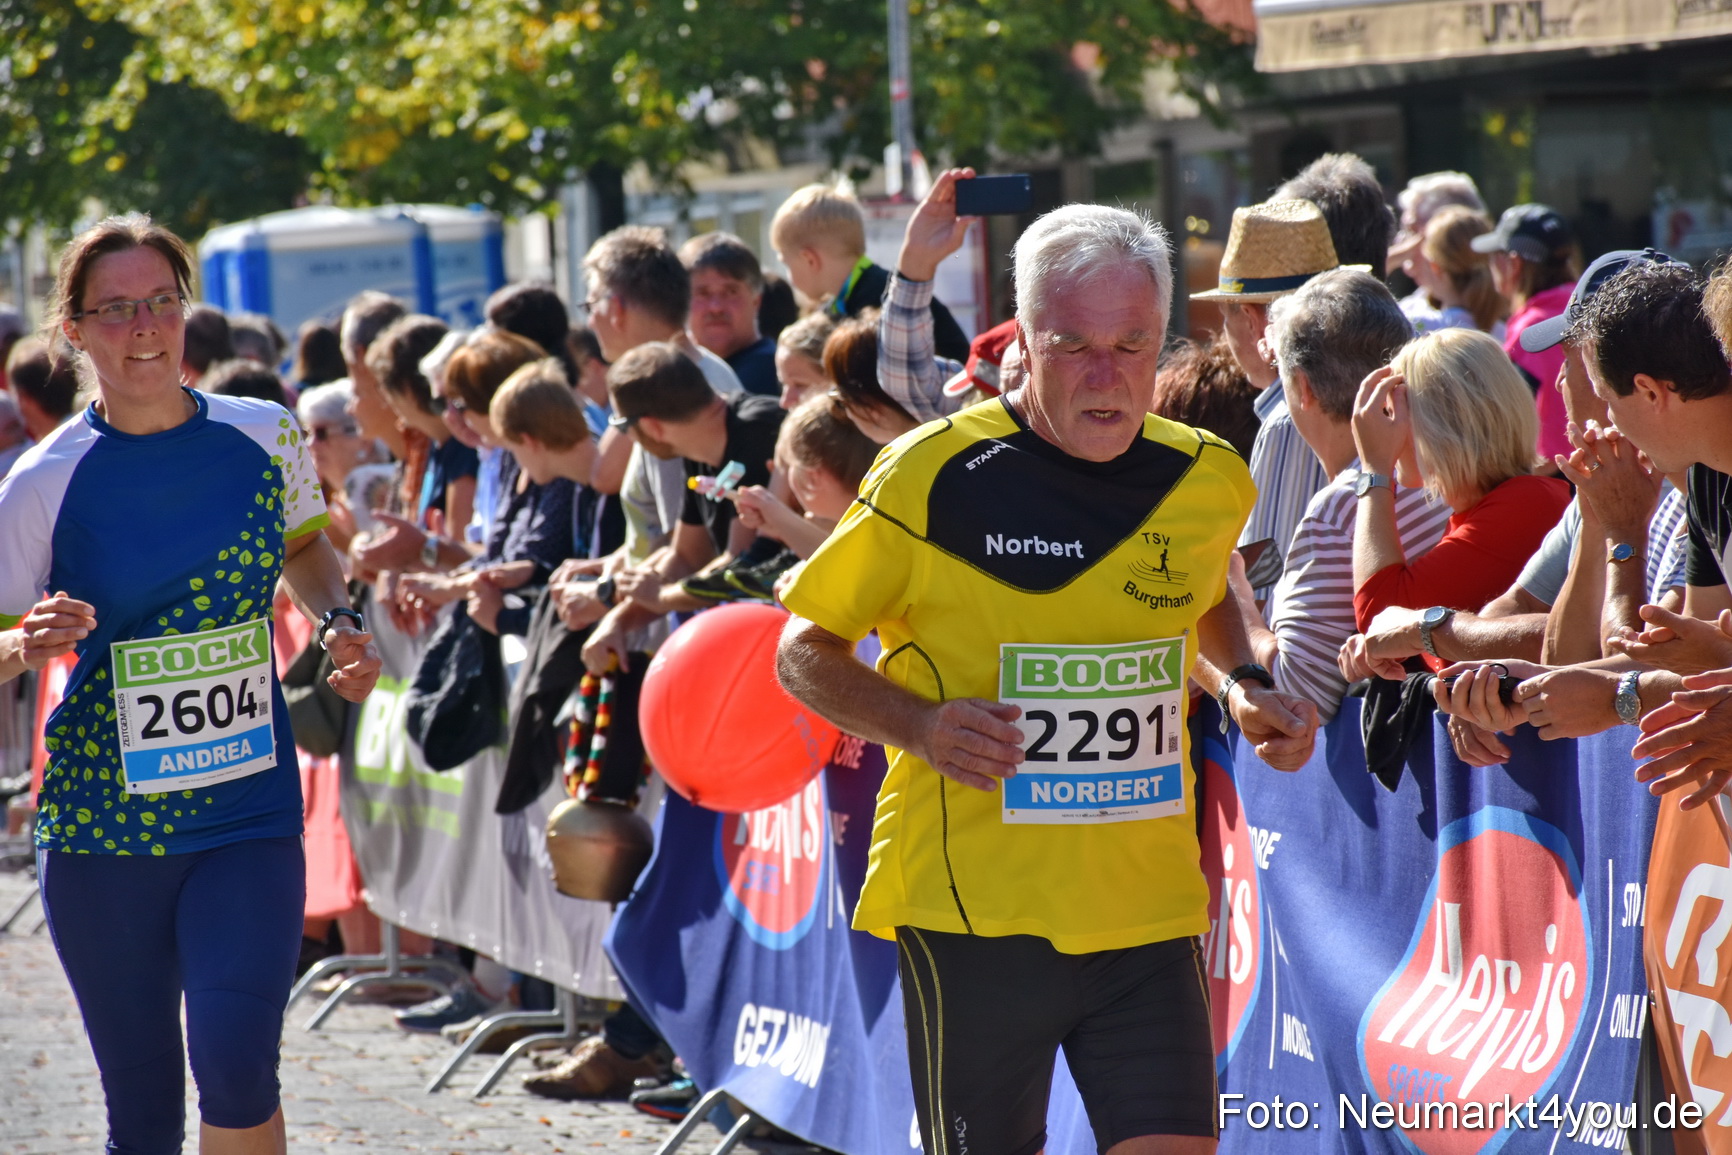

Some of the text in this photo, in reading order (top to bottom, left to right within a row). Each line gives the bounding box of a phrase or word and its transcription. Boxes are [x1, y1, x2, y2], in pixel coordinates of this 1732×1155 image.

[965, 442, 1009, 471] STANN
[985, 533, 1085, 559] Norbert
[1141, 532, 1171, 546] TSV
[1122, 580, 1194, 610] Burgthann
[127, 629, 258, 680] BOCK
[1018, 648, 1171, 691] BOCK
[137, 678, 258, 741] 2604
[832, 736, 866, 770] ORE
[1025, 704, 1164, 763] 2291
[158, 738, 253, 774] ANDREA
[1030, 774, 1164, 804] NORBERT
[1248, 824, 1282, 871] ORE
[1377, 898, 1576, 1100] Hervis
[733, 1003, 787, 1067] GET
